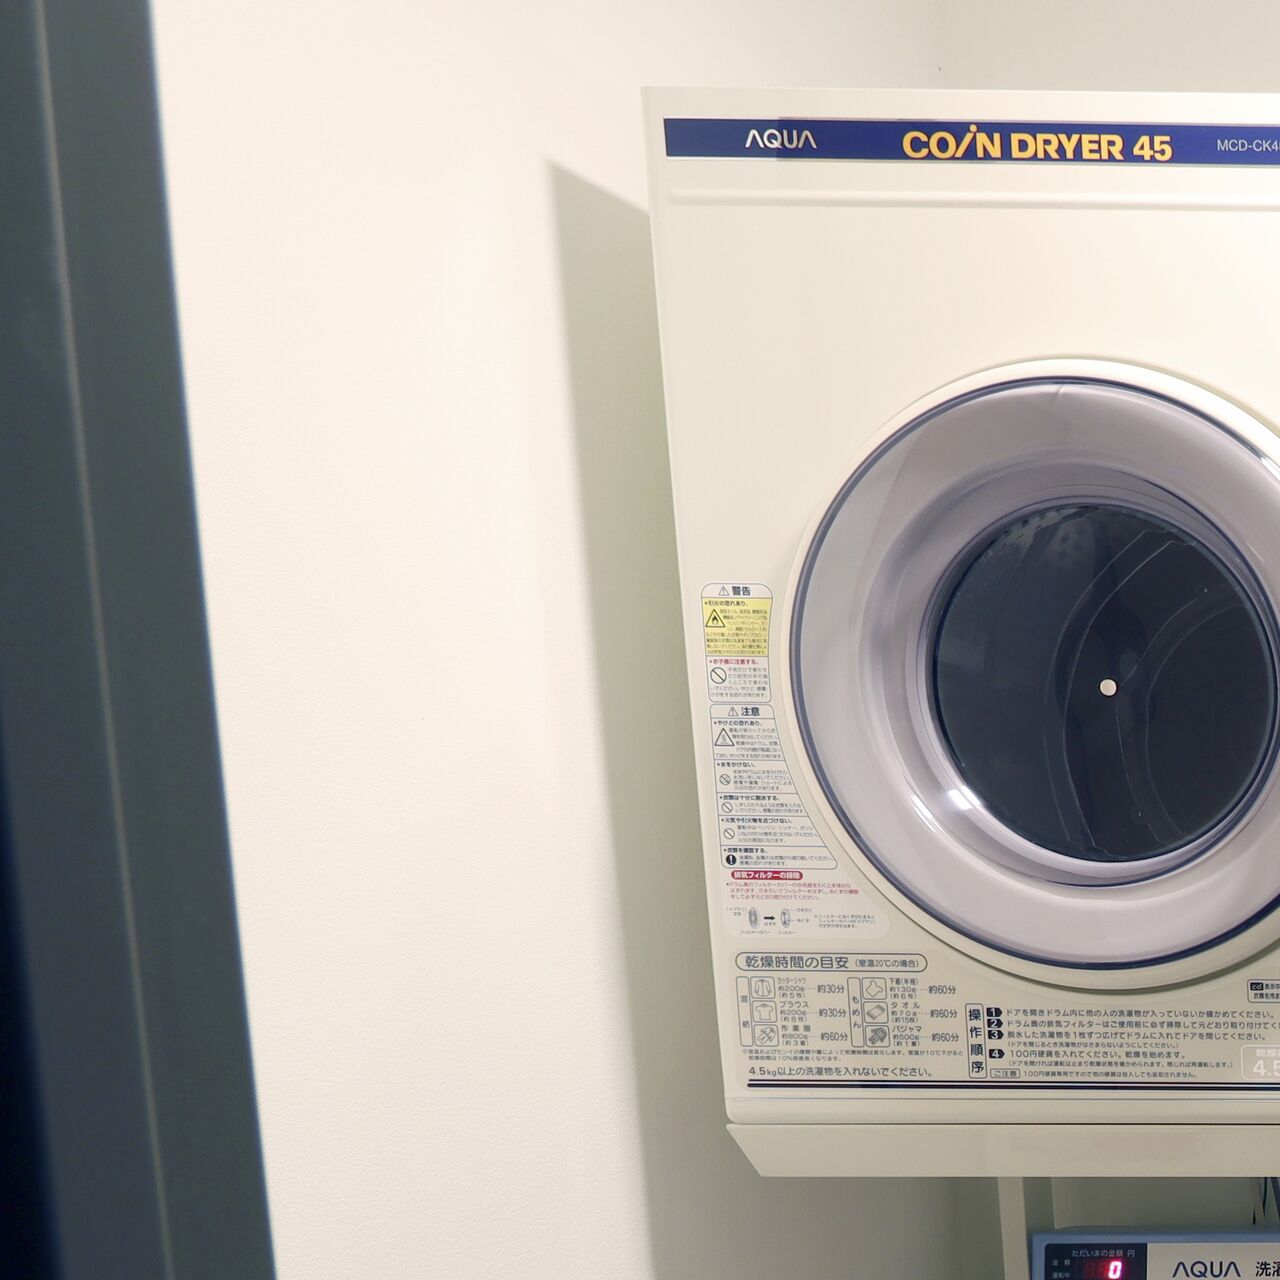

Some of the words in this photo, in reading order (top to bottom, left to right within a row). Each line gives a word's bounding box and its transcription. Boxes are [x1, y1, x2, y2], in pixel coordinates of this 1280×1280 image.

[745, 129, 817, 149] AQUA
[1011, 132, 1124, 160] DRYER
[1133, 134, 1173, 161] 45
[732, 586, 750, 596] 警告
[741, 706, 760, 716] 注意
[745, 955, 849, 969] 乾燥時間の目安
[968, 1008, 985, 1074] 操作順序
[1127, 1249, 1136, 1258] 円
[1108, 1260, 1122, 1279] 0
[1172, 1260, 1241, 1278] AQUA
